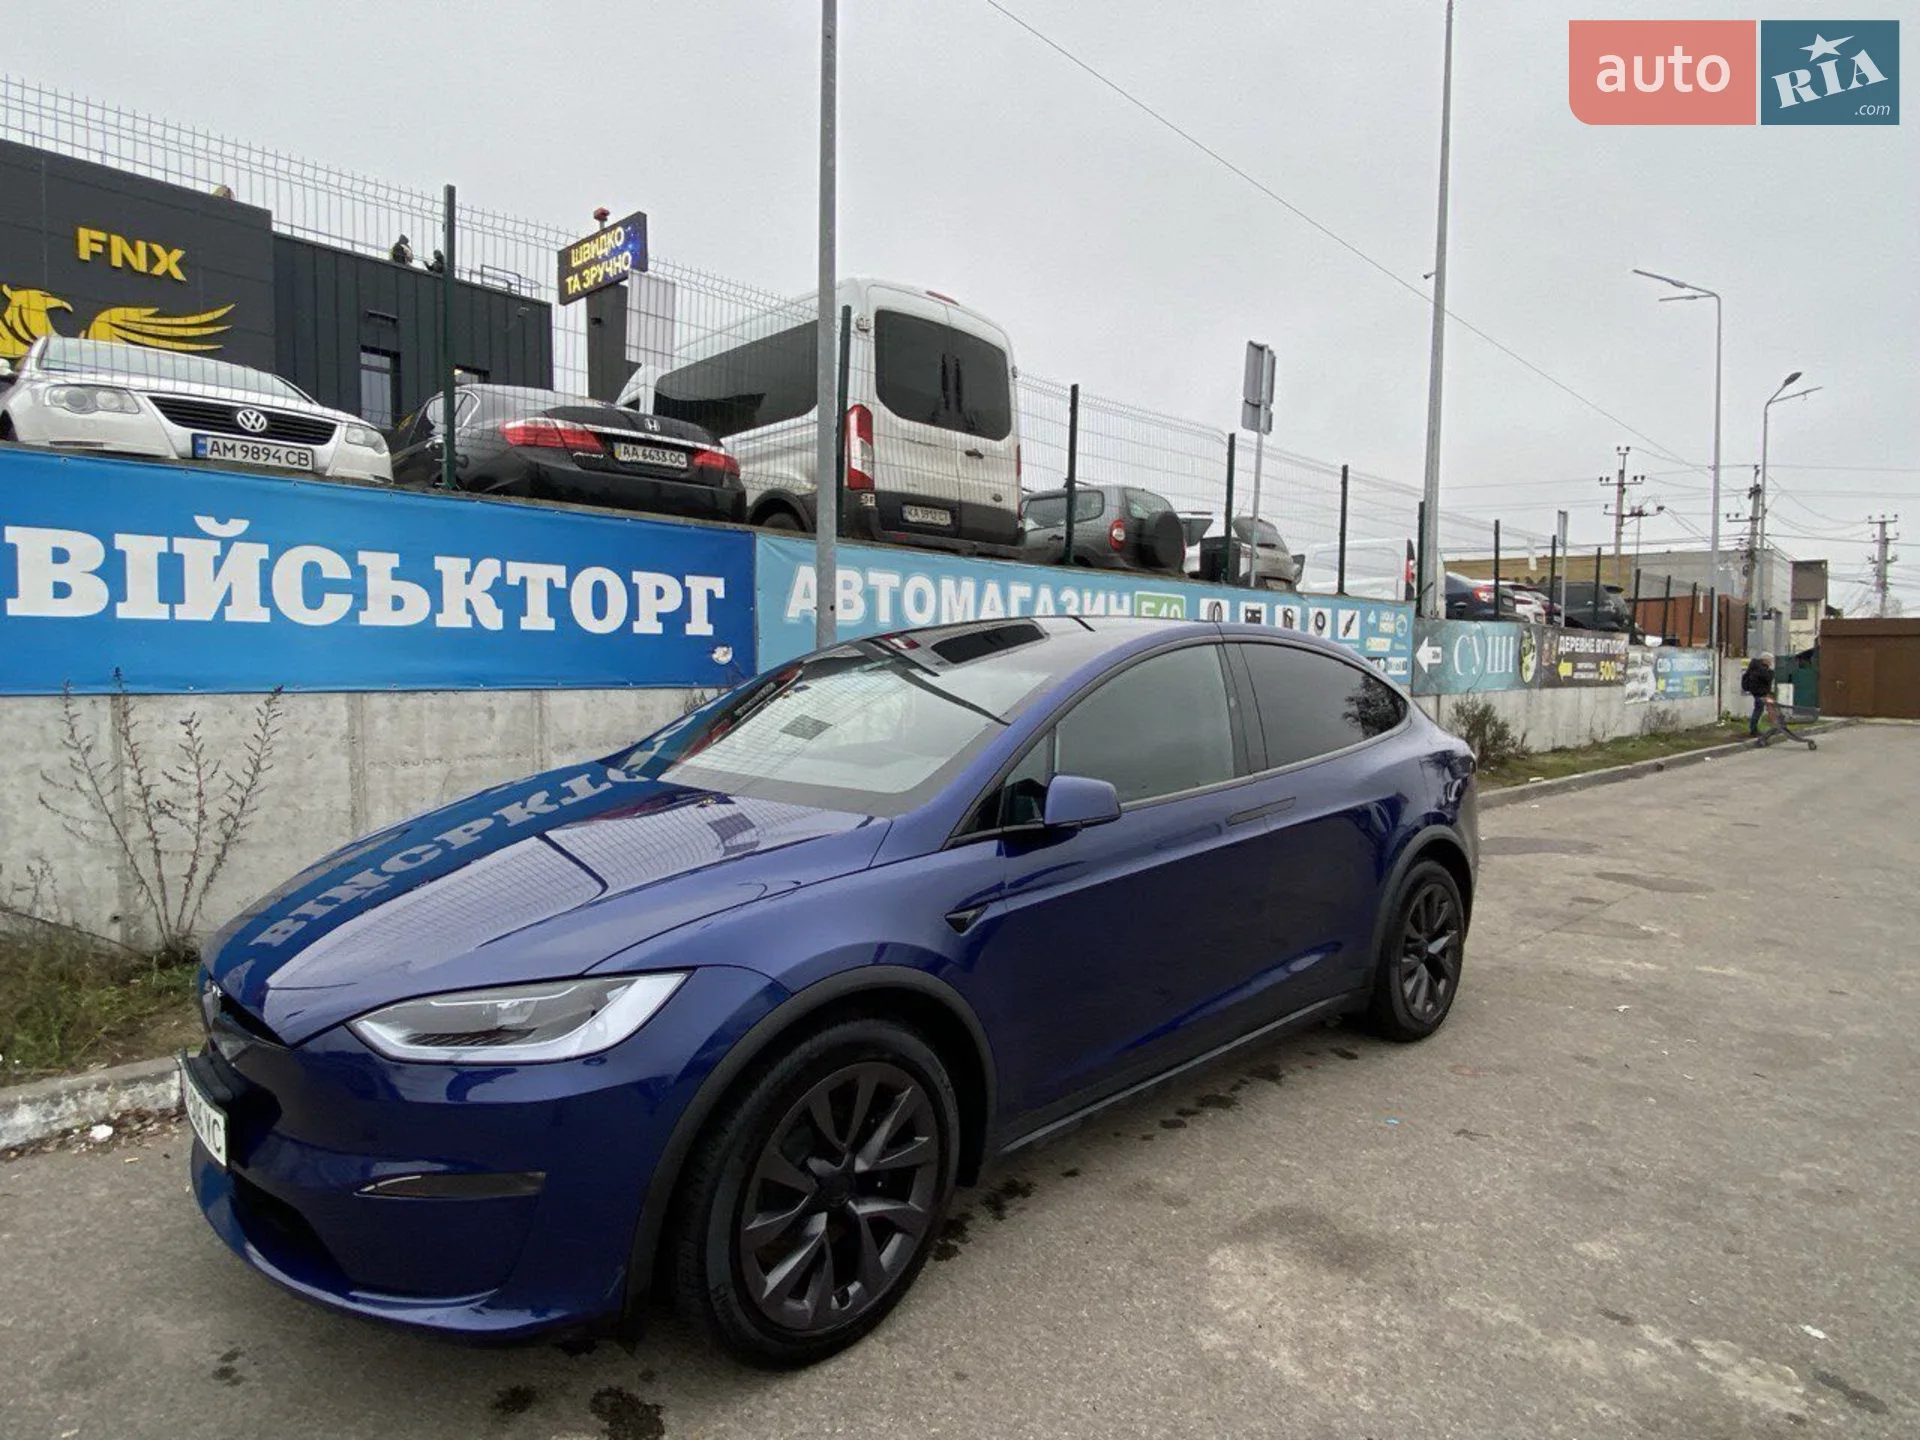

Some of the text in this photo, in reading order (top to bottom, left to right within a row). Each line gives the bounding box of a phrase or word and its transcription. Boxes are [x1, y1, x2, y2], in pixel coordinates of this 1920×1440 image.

[78, 227, 187, 282] FNX
[571, 227, 625, 268] ШВИДКО
[565, 251, 633, 295] ТА ЗРУЧНО
[209, 440, 310, 467] AM 9894 CB
[4, 514, 726, 637] ВІЙСЬКТОРГ
[785, 564, 1132, 625] АВТОМАГАЗИН
[1600, 660, 1617, 681] 500
